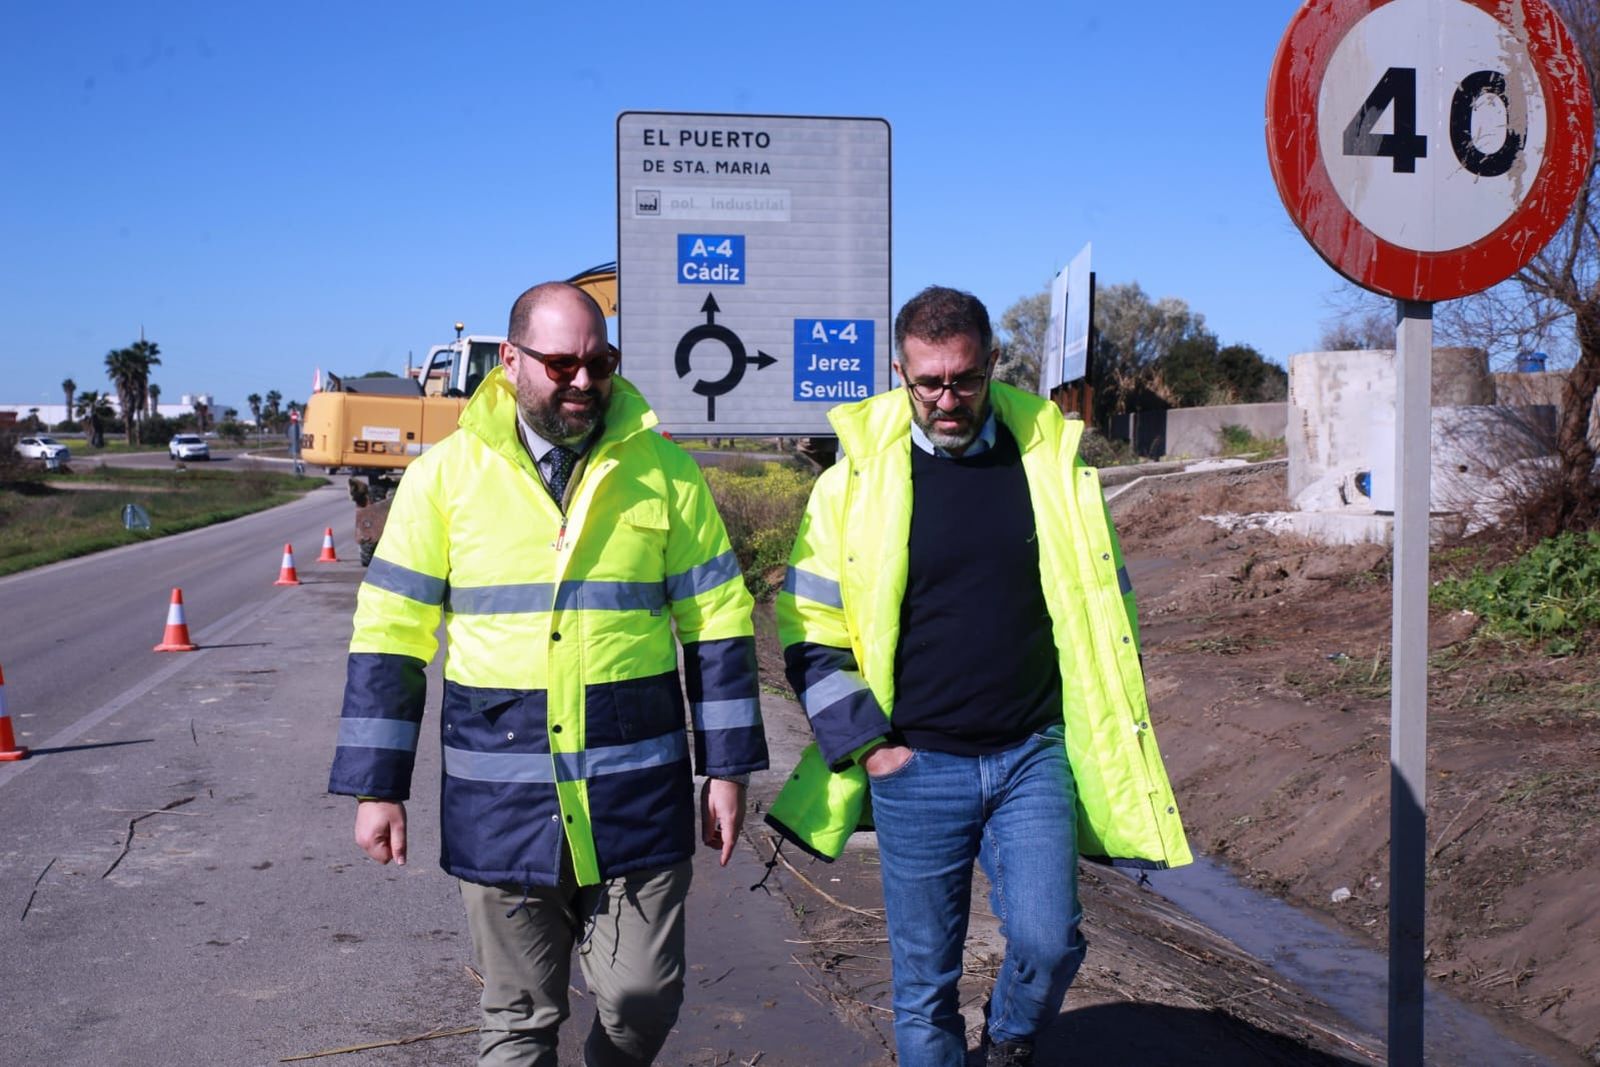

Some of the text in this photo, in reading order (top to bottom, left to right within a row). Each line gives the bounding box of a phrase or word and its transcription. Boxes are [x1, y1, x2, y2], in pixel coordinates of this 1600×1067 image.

[1342, 66, 1529, 177] 40
[643, 129, 771, 149] EL PUERTO
[643, 159, 771, 175] DE STA. MARIA
[711, 196, 785, 211] industrial
[690, 238, 733, 258] A-4
[682, 262, 740, 281] Cádiz
[811, 321, 858, 344] A-4
[807, 354, 861, 371] Jerez
[799, 380, 869, 398] Sevilla
